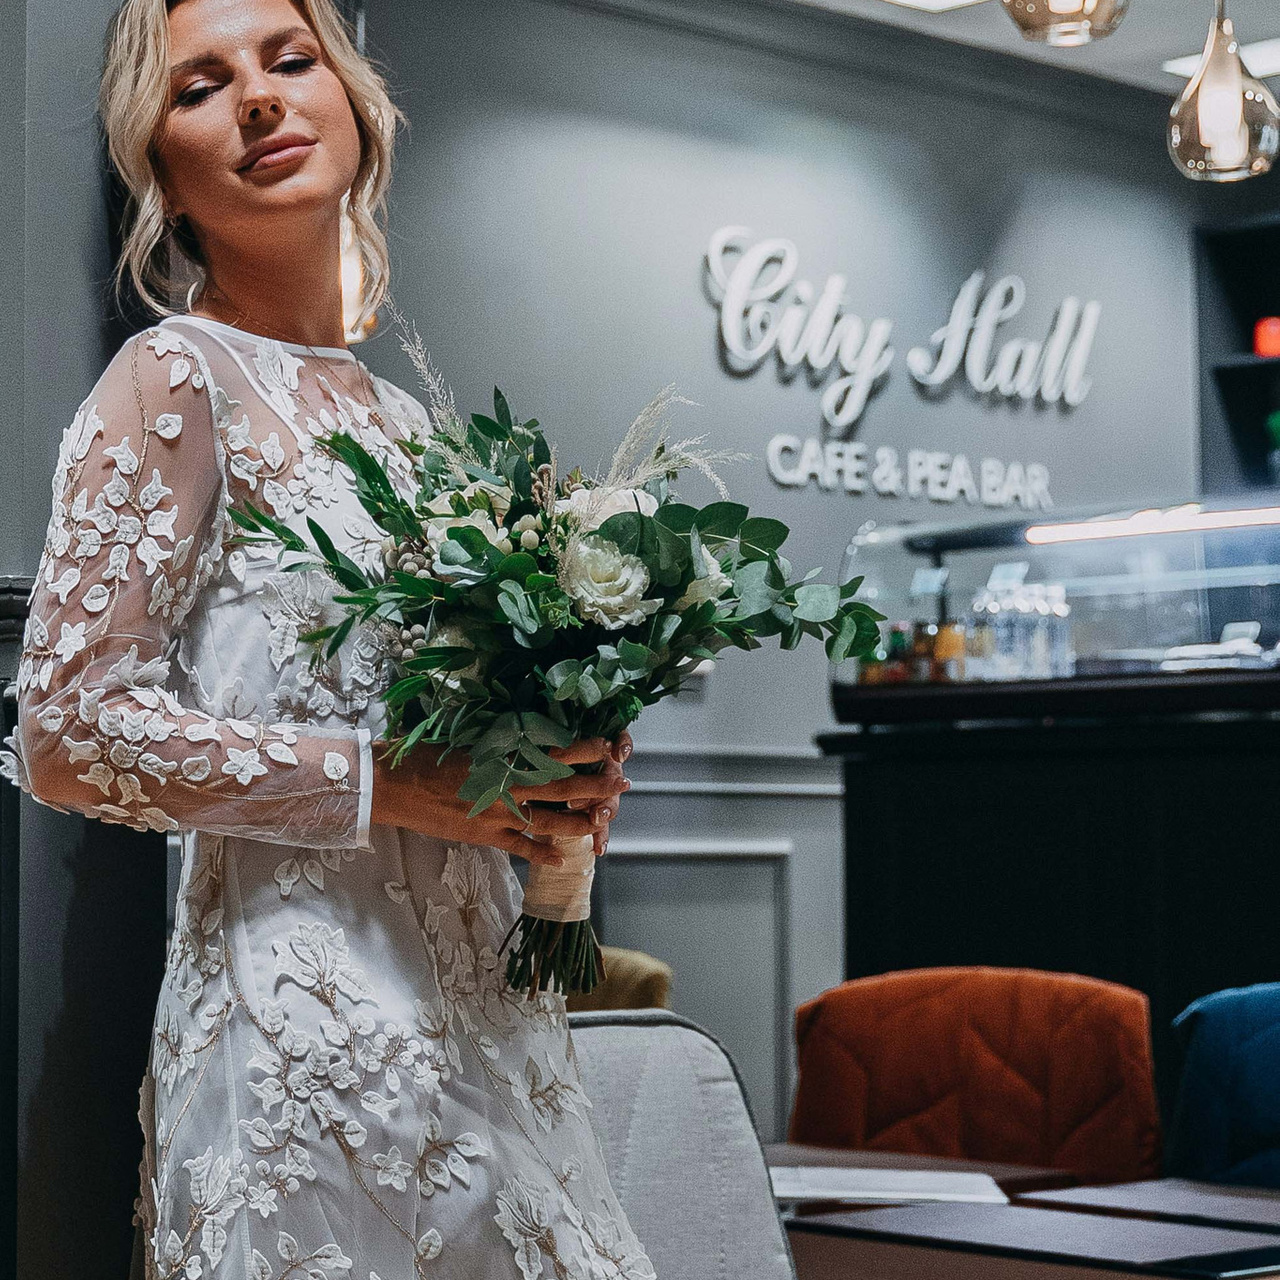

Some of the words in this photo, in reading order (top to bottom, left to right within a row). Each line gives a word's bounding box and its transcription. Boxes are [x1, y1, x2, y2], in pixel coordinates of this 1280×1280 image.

[708, 225, 895, 427] City
[907, 269, 1101, 406] Hall
[767, 434, 869, 491] CAFE
[872, 446, 901, 495] &
[981, 457, 1054, 512] BAR
